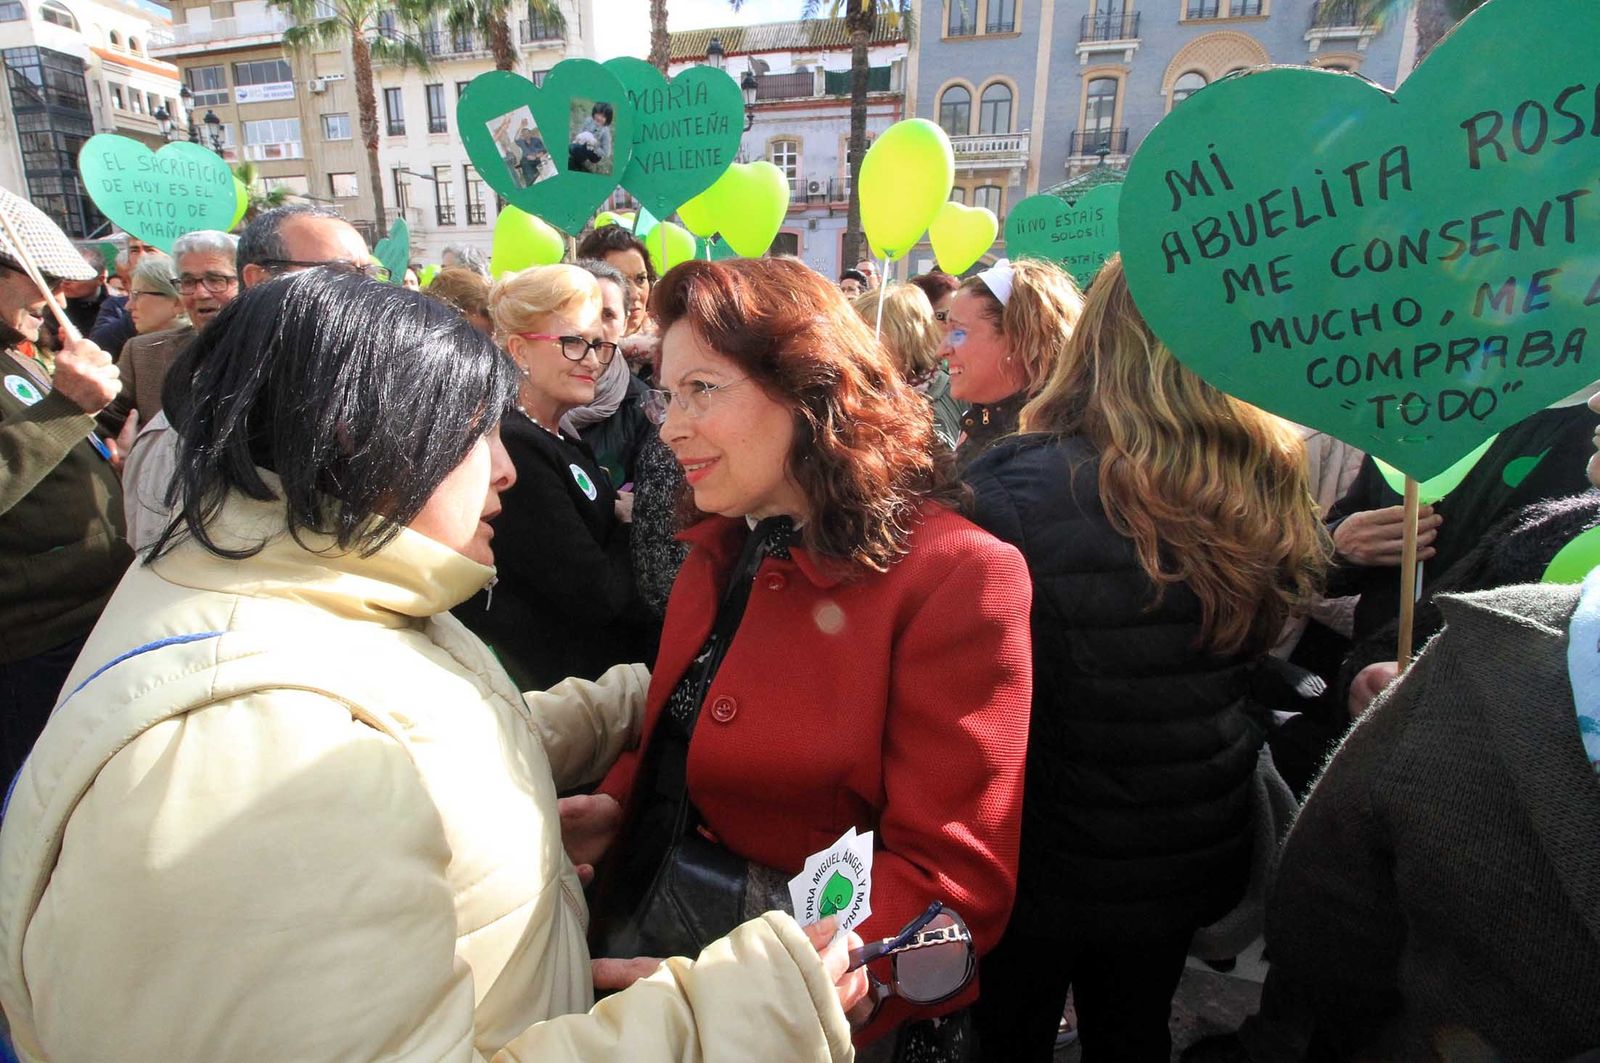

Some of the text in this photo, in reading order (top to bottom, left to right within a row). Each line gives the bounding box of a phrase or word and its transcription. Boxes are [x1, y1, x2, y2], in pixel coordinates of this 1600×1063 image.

[632, 111, 728, 145] MONTEÑA
[102, 152, 227, 185] EL SACRIFICIO
[635, 146, 722, 174] VALIENTE
[1165, 143, 1234, 212] MI
[102, 178, 213, 198] DE HOY ES EL
[140, 221, 202, 238] MAÑA
[187, 203, 208, 217] DE
[1161, 145, 1413, 274] ABUELITA
[1223, 178, 1600, 304] ME CONSENT
[1472, 268, 1563, 318] ME
[1306, 328, 1588, 389] COMPRABA
[805, 887, 817, 919] PARA
[812, 852, 840, 885] MIGUEL
[858, 879, 866, 887] Y
